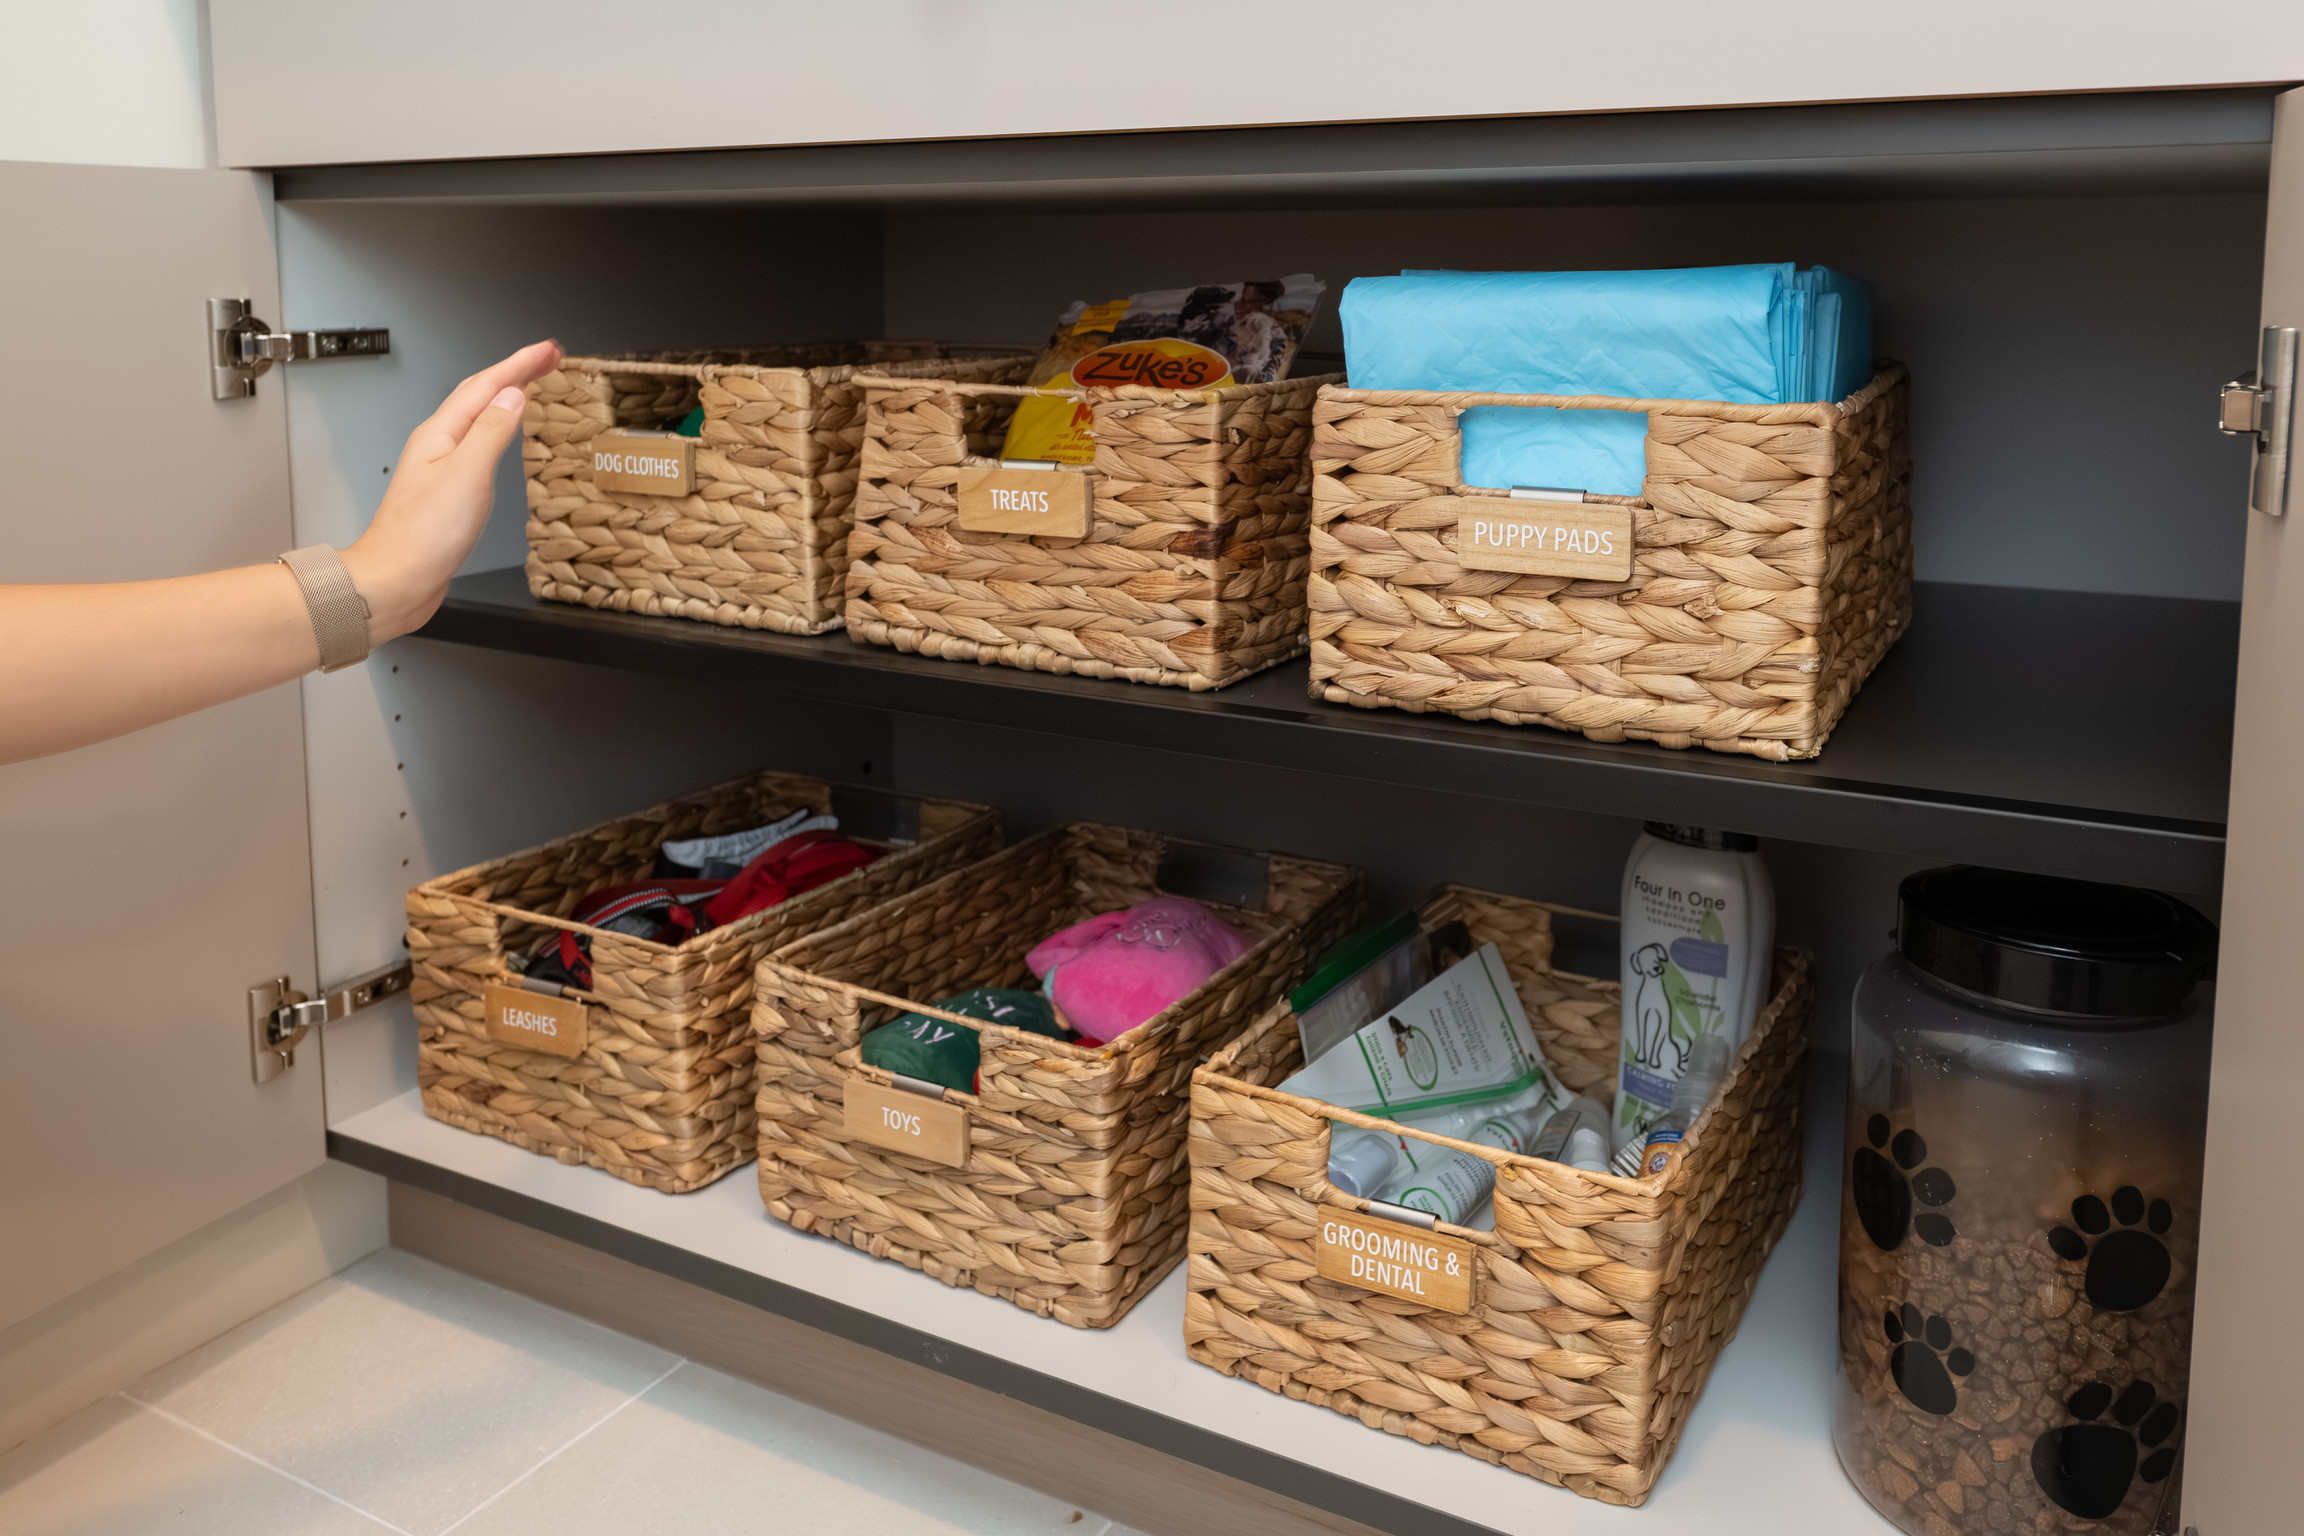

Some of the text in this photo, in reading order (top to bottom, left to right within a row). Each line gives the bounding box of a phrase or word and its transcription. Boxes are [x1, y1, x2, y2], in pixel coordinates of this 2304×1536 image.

[595, 453, 679, 478] DOG CLOTHES
[990, 489, 1049, 512] TREATS
[1474, 521, 1613, 555] PUPPY PADS
[1635, 875, 1726, 910] Four In One
[502, 1007, 557, 1036] LEASHES
[881, 1106, 921, 1136] TOYS
[1324, 1222, 1460, 1277] GROOMING &
[1351, 1254, 1425, 1295] DENTAL
